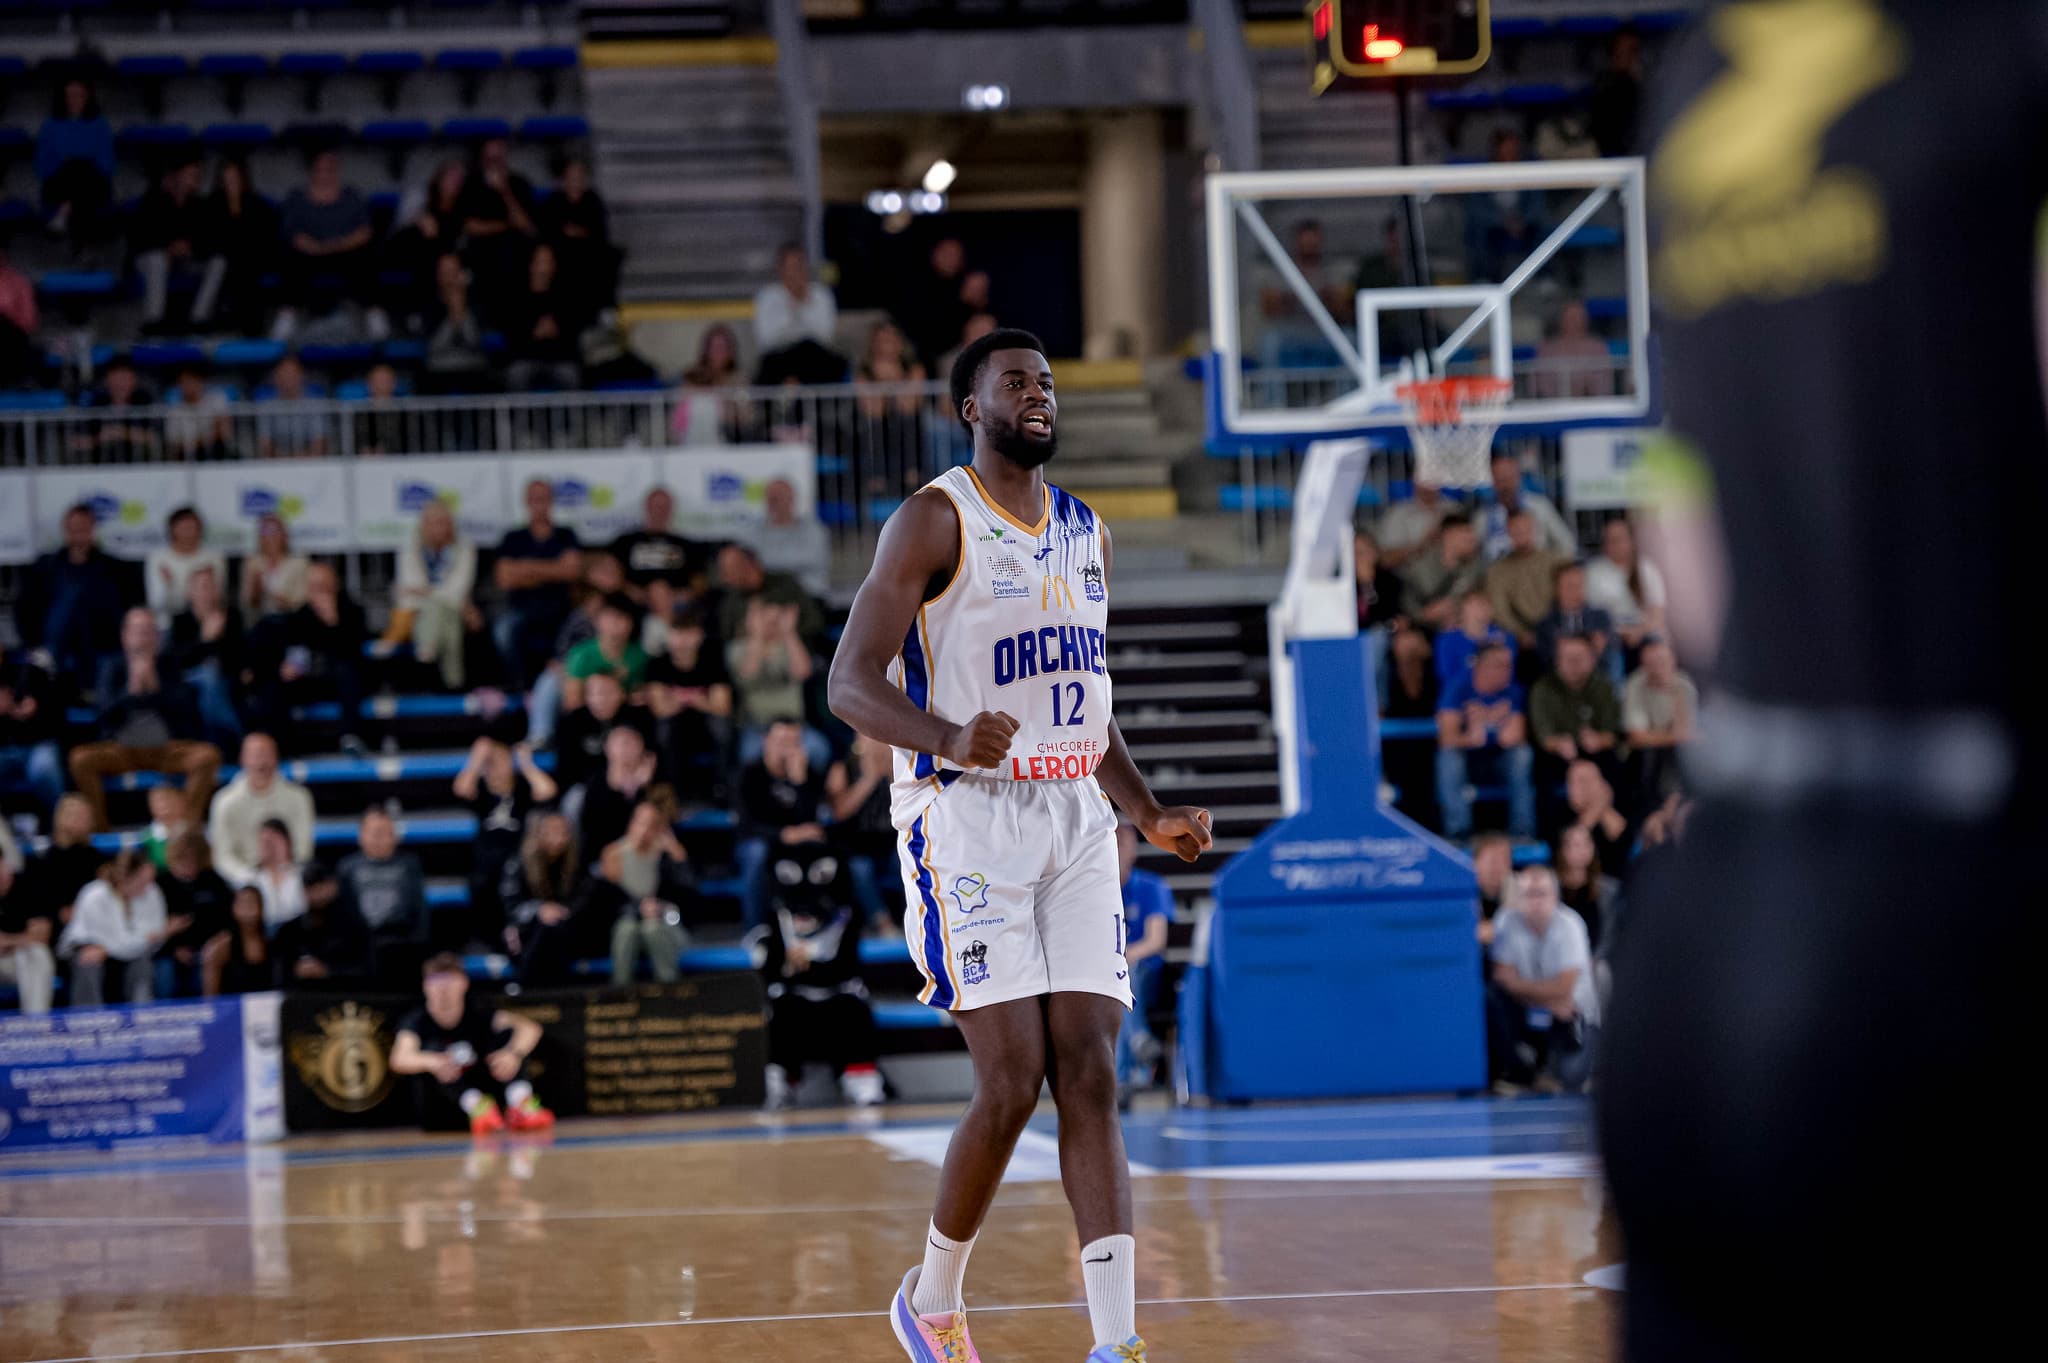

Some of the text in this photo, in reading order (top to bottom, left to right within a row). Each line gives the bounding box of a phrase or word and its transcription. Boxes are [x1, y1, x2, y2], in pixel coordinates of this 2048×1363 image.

[993, 586, 1030, 595] Carembault
[1050, 681, 1086, 727] 12
[1037, 738, 1098, 752] CHICORÉE
[951, 917, 1005, 935] Hauts-de-France
